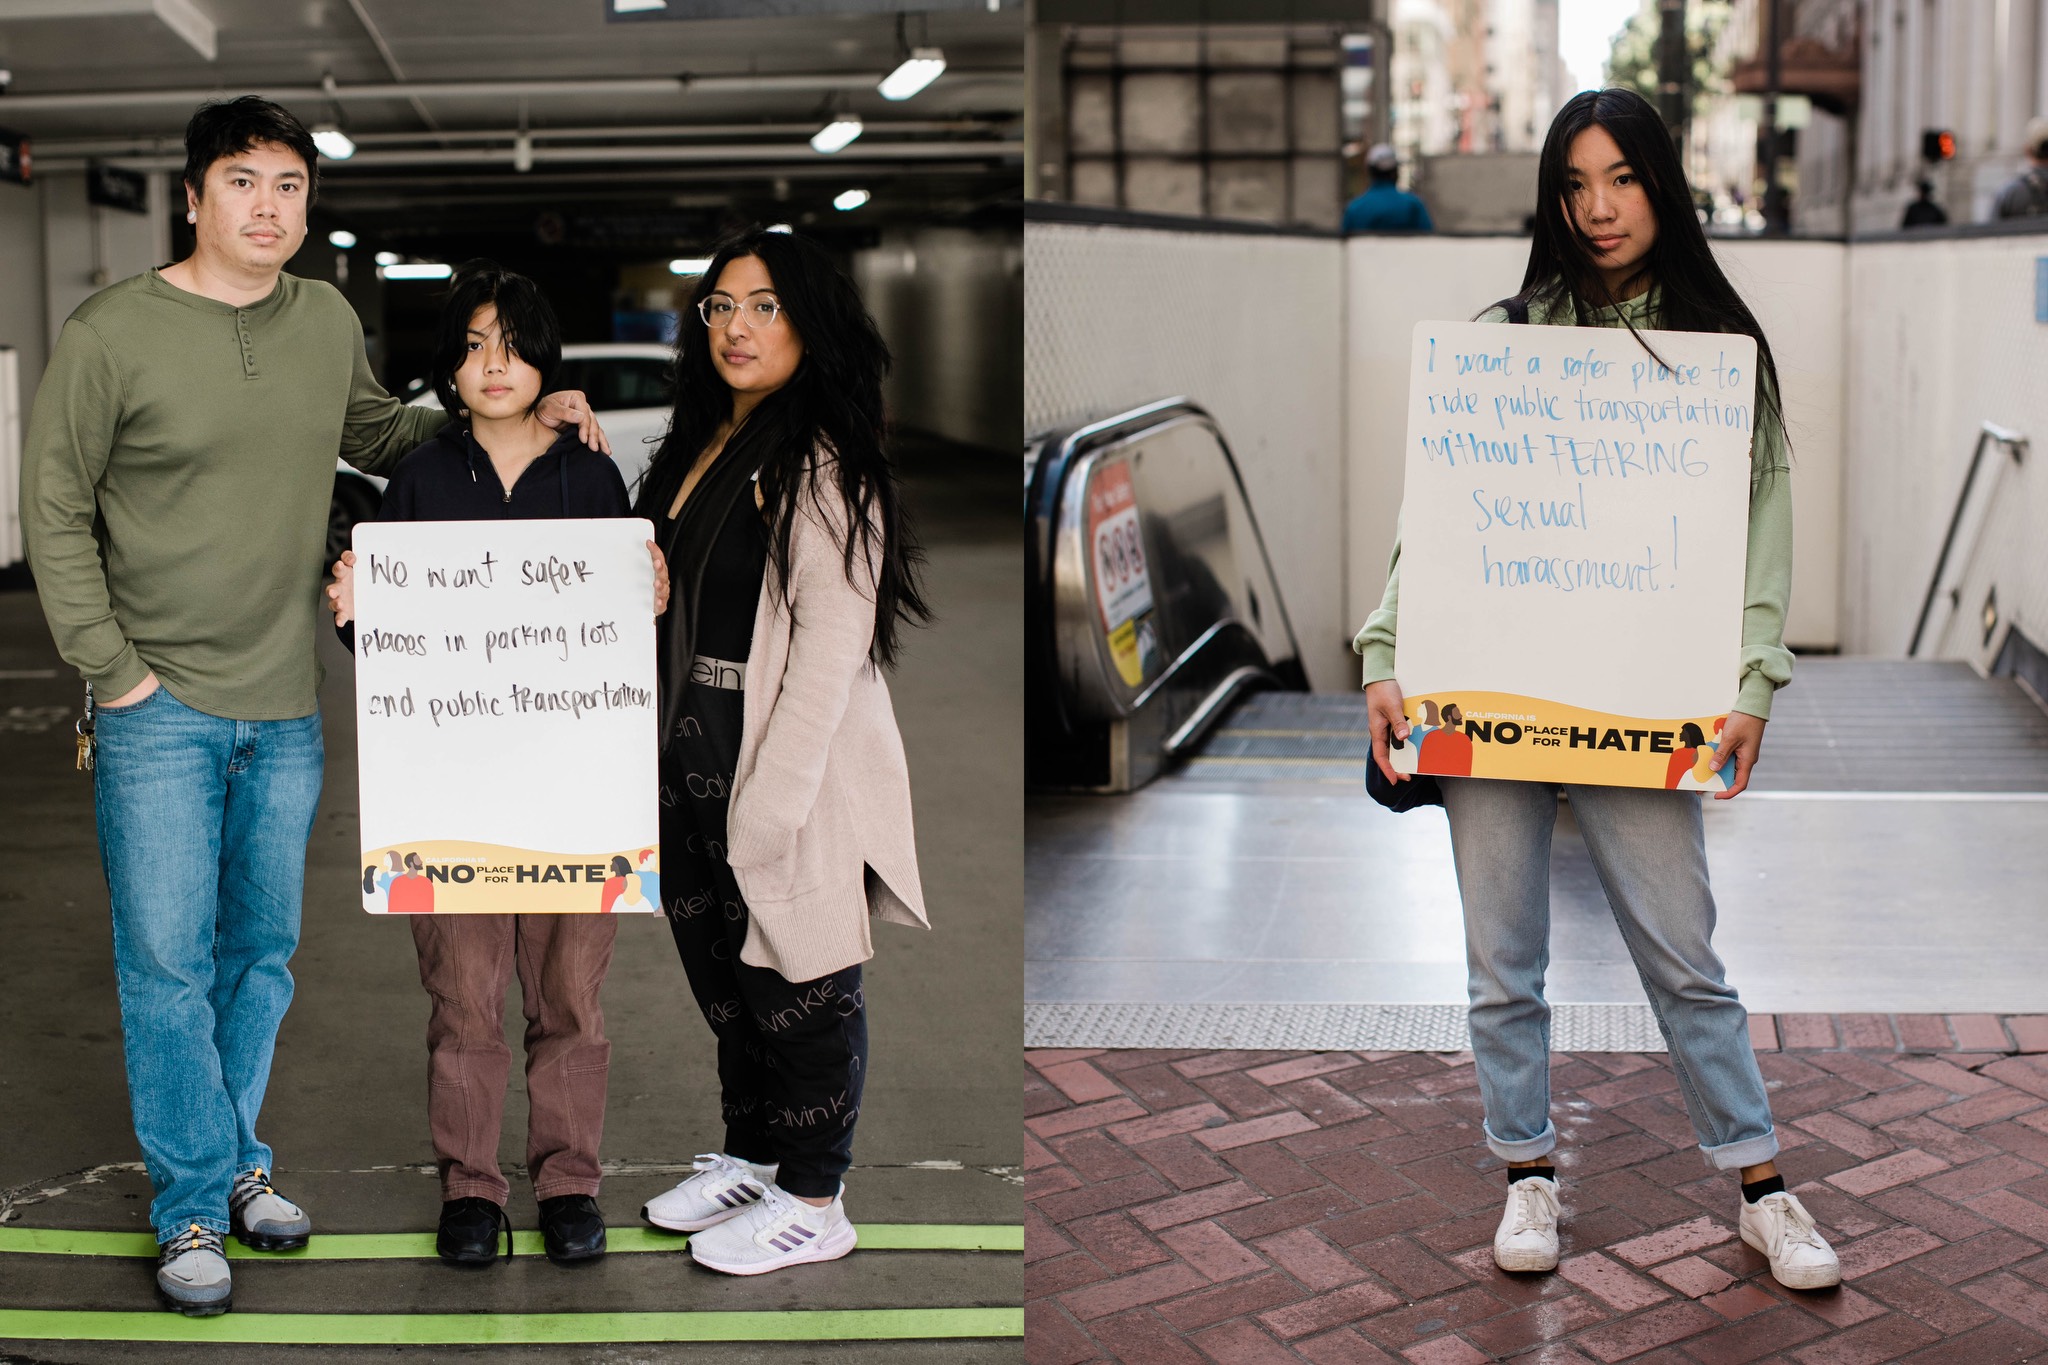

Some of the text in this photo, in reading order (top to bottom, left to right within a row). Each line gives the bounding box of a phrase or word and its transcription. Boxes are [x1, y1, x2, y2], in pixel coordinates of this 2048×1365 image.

[1427, 338, 1740, 393] I want a safer place to
[1428, 385, 1749, 434] ride public transportation
[1422, 429, 1709, 478] without FEARING
[370, 553, 409, 587] We
[427, 551, 498, 588] want
[361, 621, 618, 662] places in parking lots
[368, 687, 416, 717] and
[428, 689, 504, 727] public
[1465, 711, 1537, 722] CALIFORNIA IS
[1464, 719, 1675, 753] NO PLACE FOR HATE
[425, 865, 475, 884] NO
[476, 866, 515, 874] PLACE
[516, 864, 606, 883] HATE
